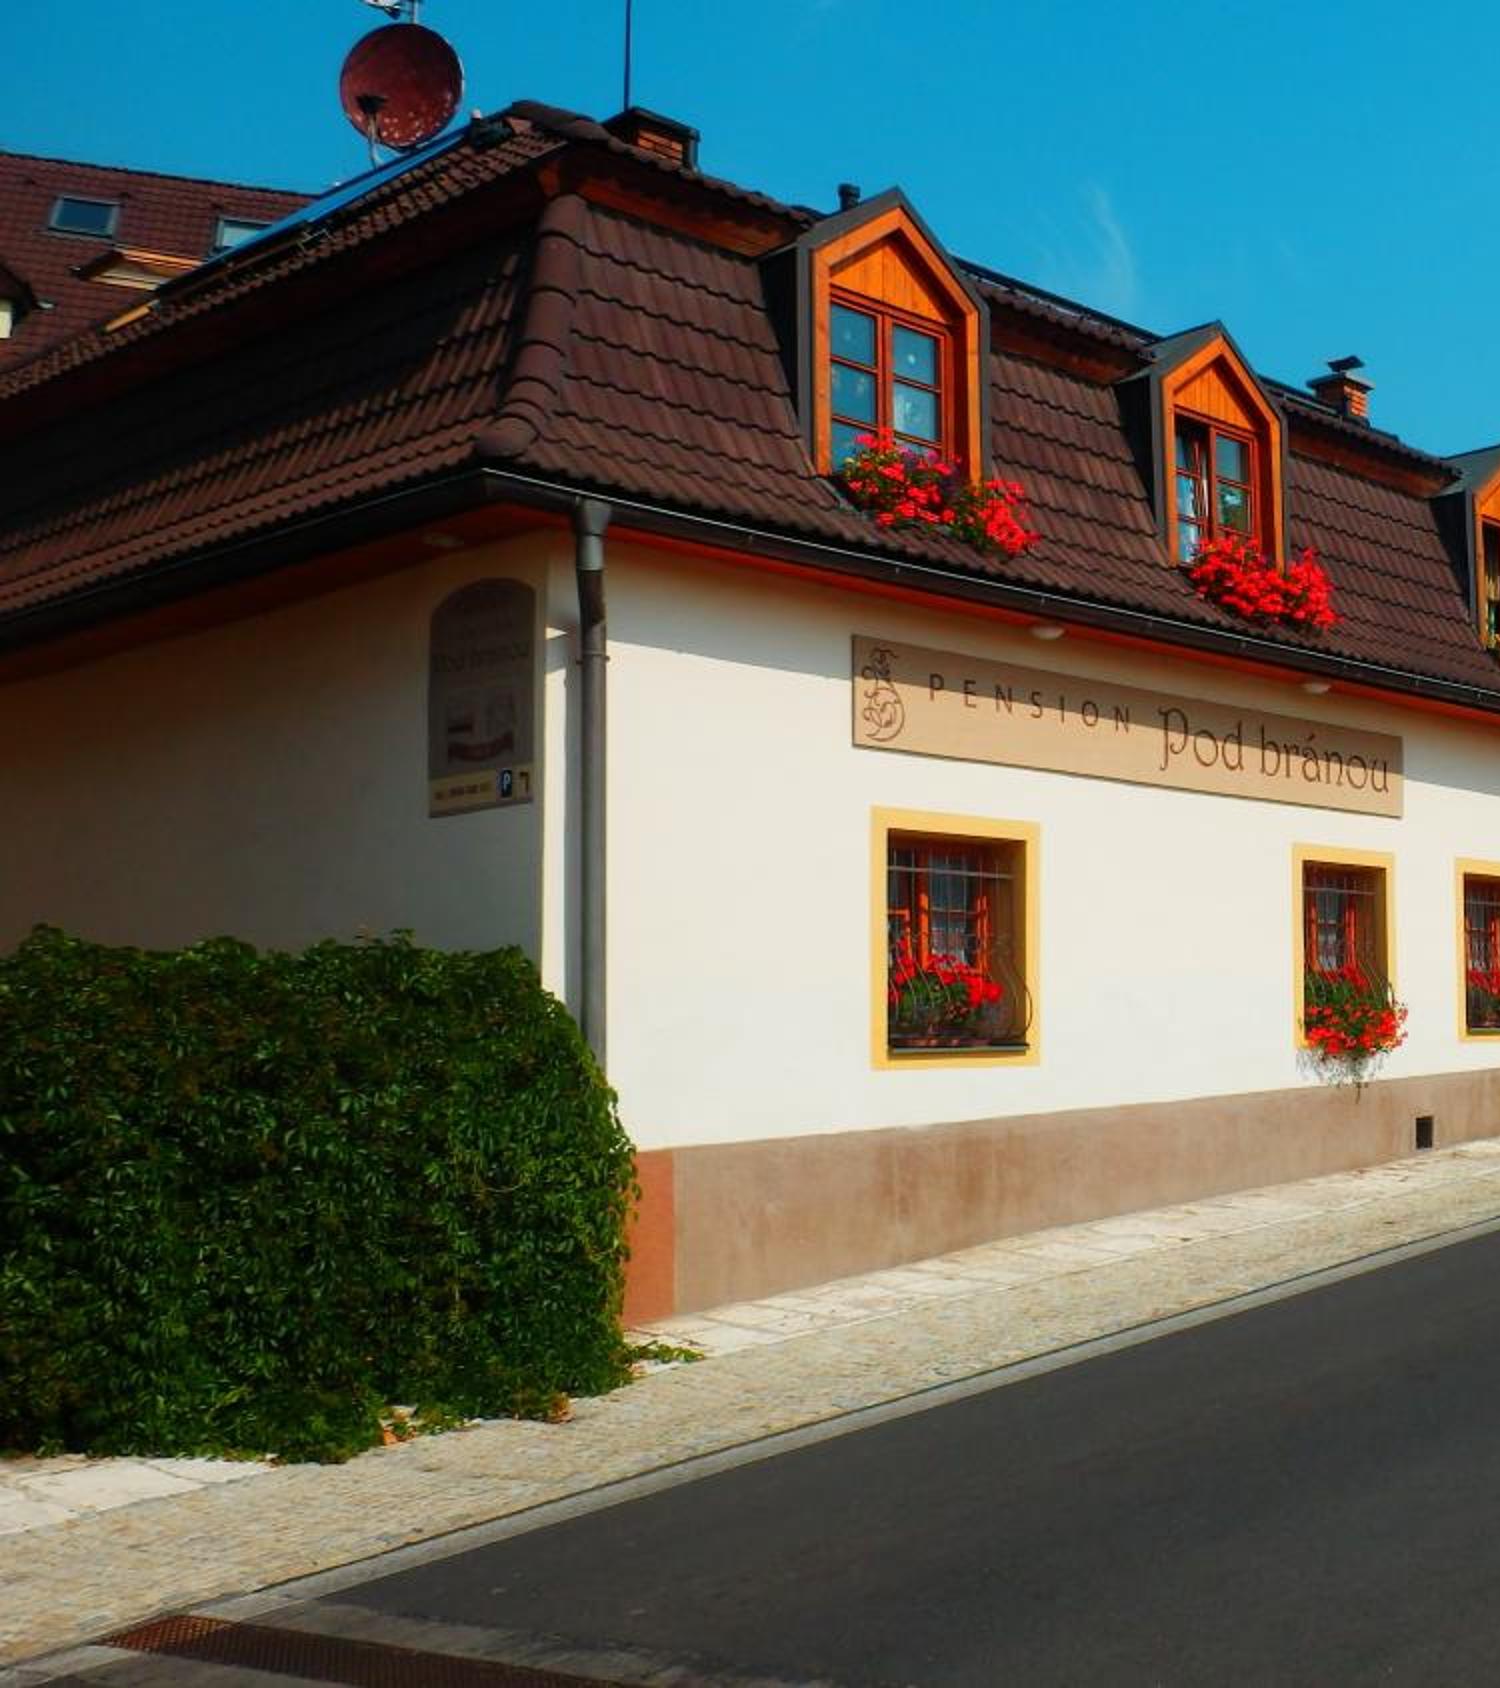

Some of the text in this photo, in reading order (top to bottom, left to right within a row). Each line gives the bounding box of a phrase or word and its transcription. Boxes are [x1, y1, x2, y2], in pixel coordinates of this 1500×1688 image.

[928, 673, 1390, 793] PENSION Pod bránou
